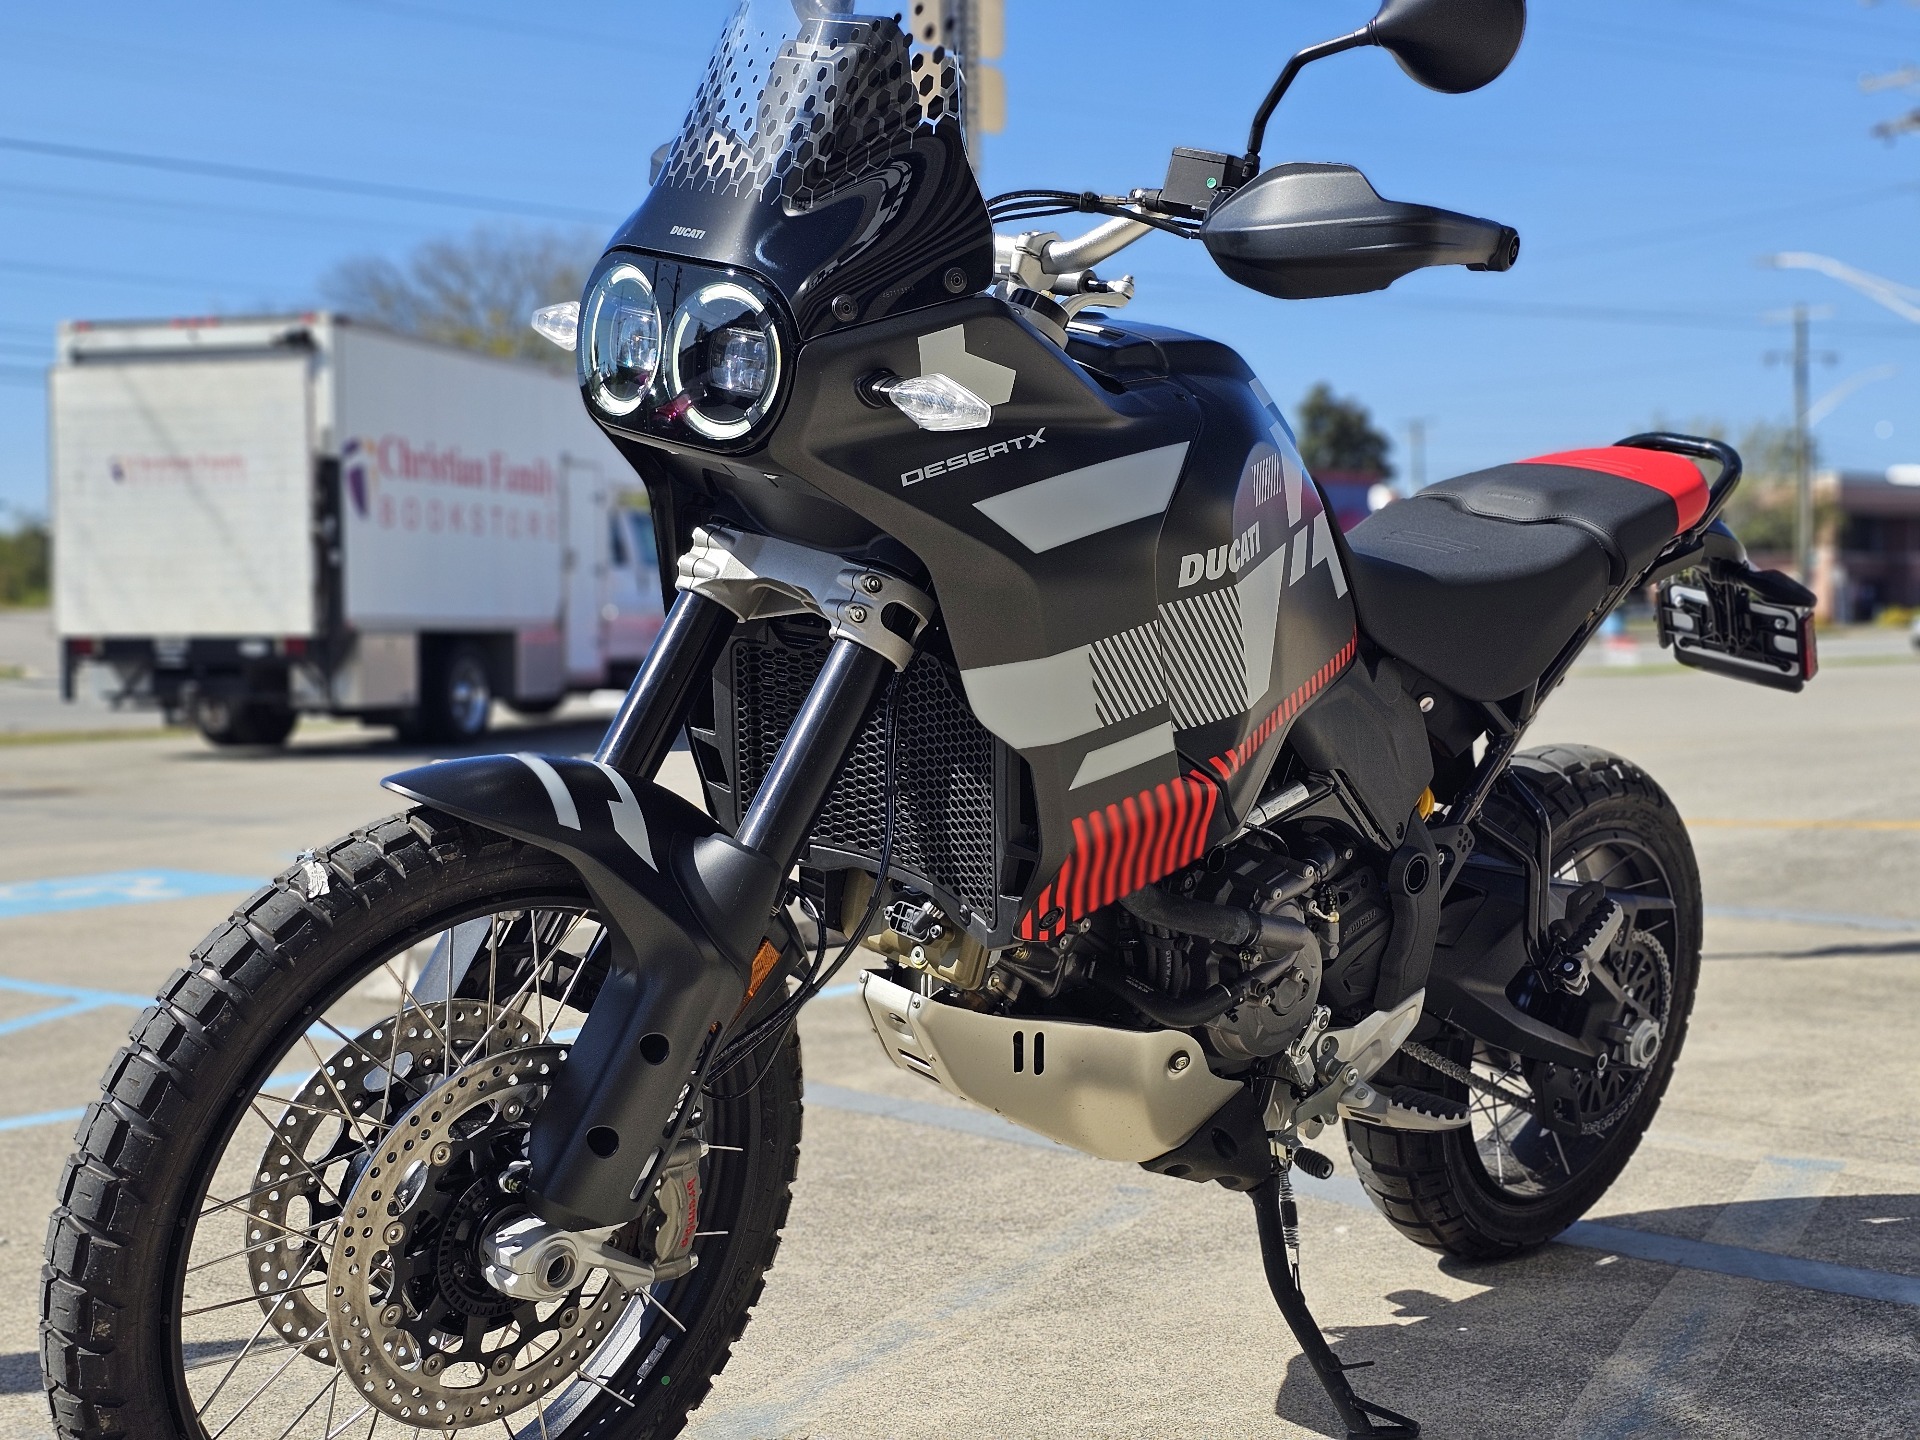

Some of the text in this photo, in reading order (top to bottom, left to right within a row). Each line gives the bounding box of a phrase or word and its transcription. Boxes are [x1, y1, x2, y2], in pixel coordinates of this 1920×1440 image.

[670, 225, 706, 240] DUCATI
[377, 434, 557, 504] Christian Family
[900, 426, 1047, 488] DESERTX
[378, 495, 558, 543] BOOKSTORE
[1178, 520, 1261, 588] DUCATI
[680, 1175, 697, 1248] brembo
